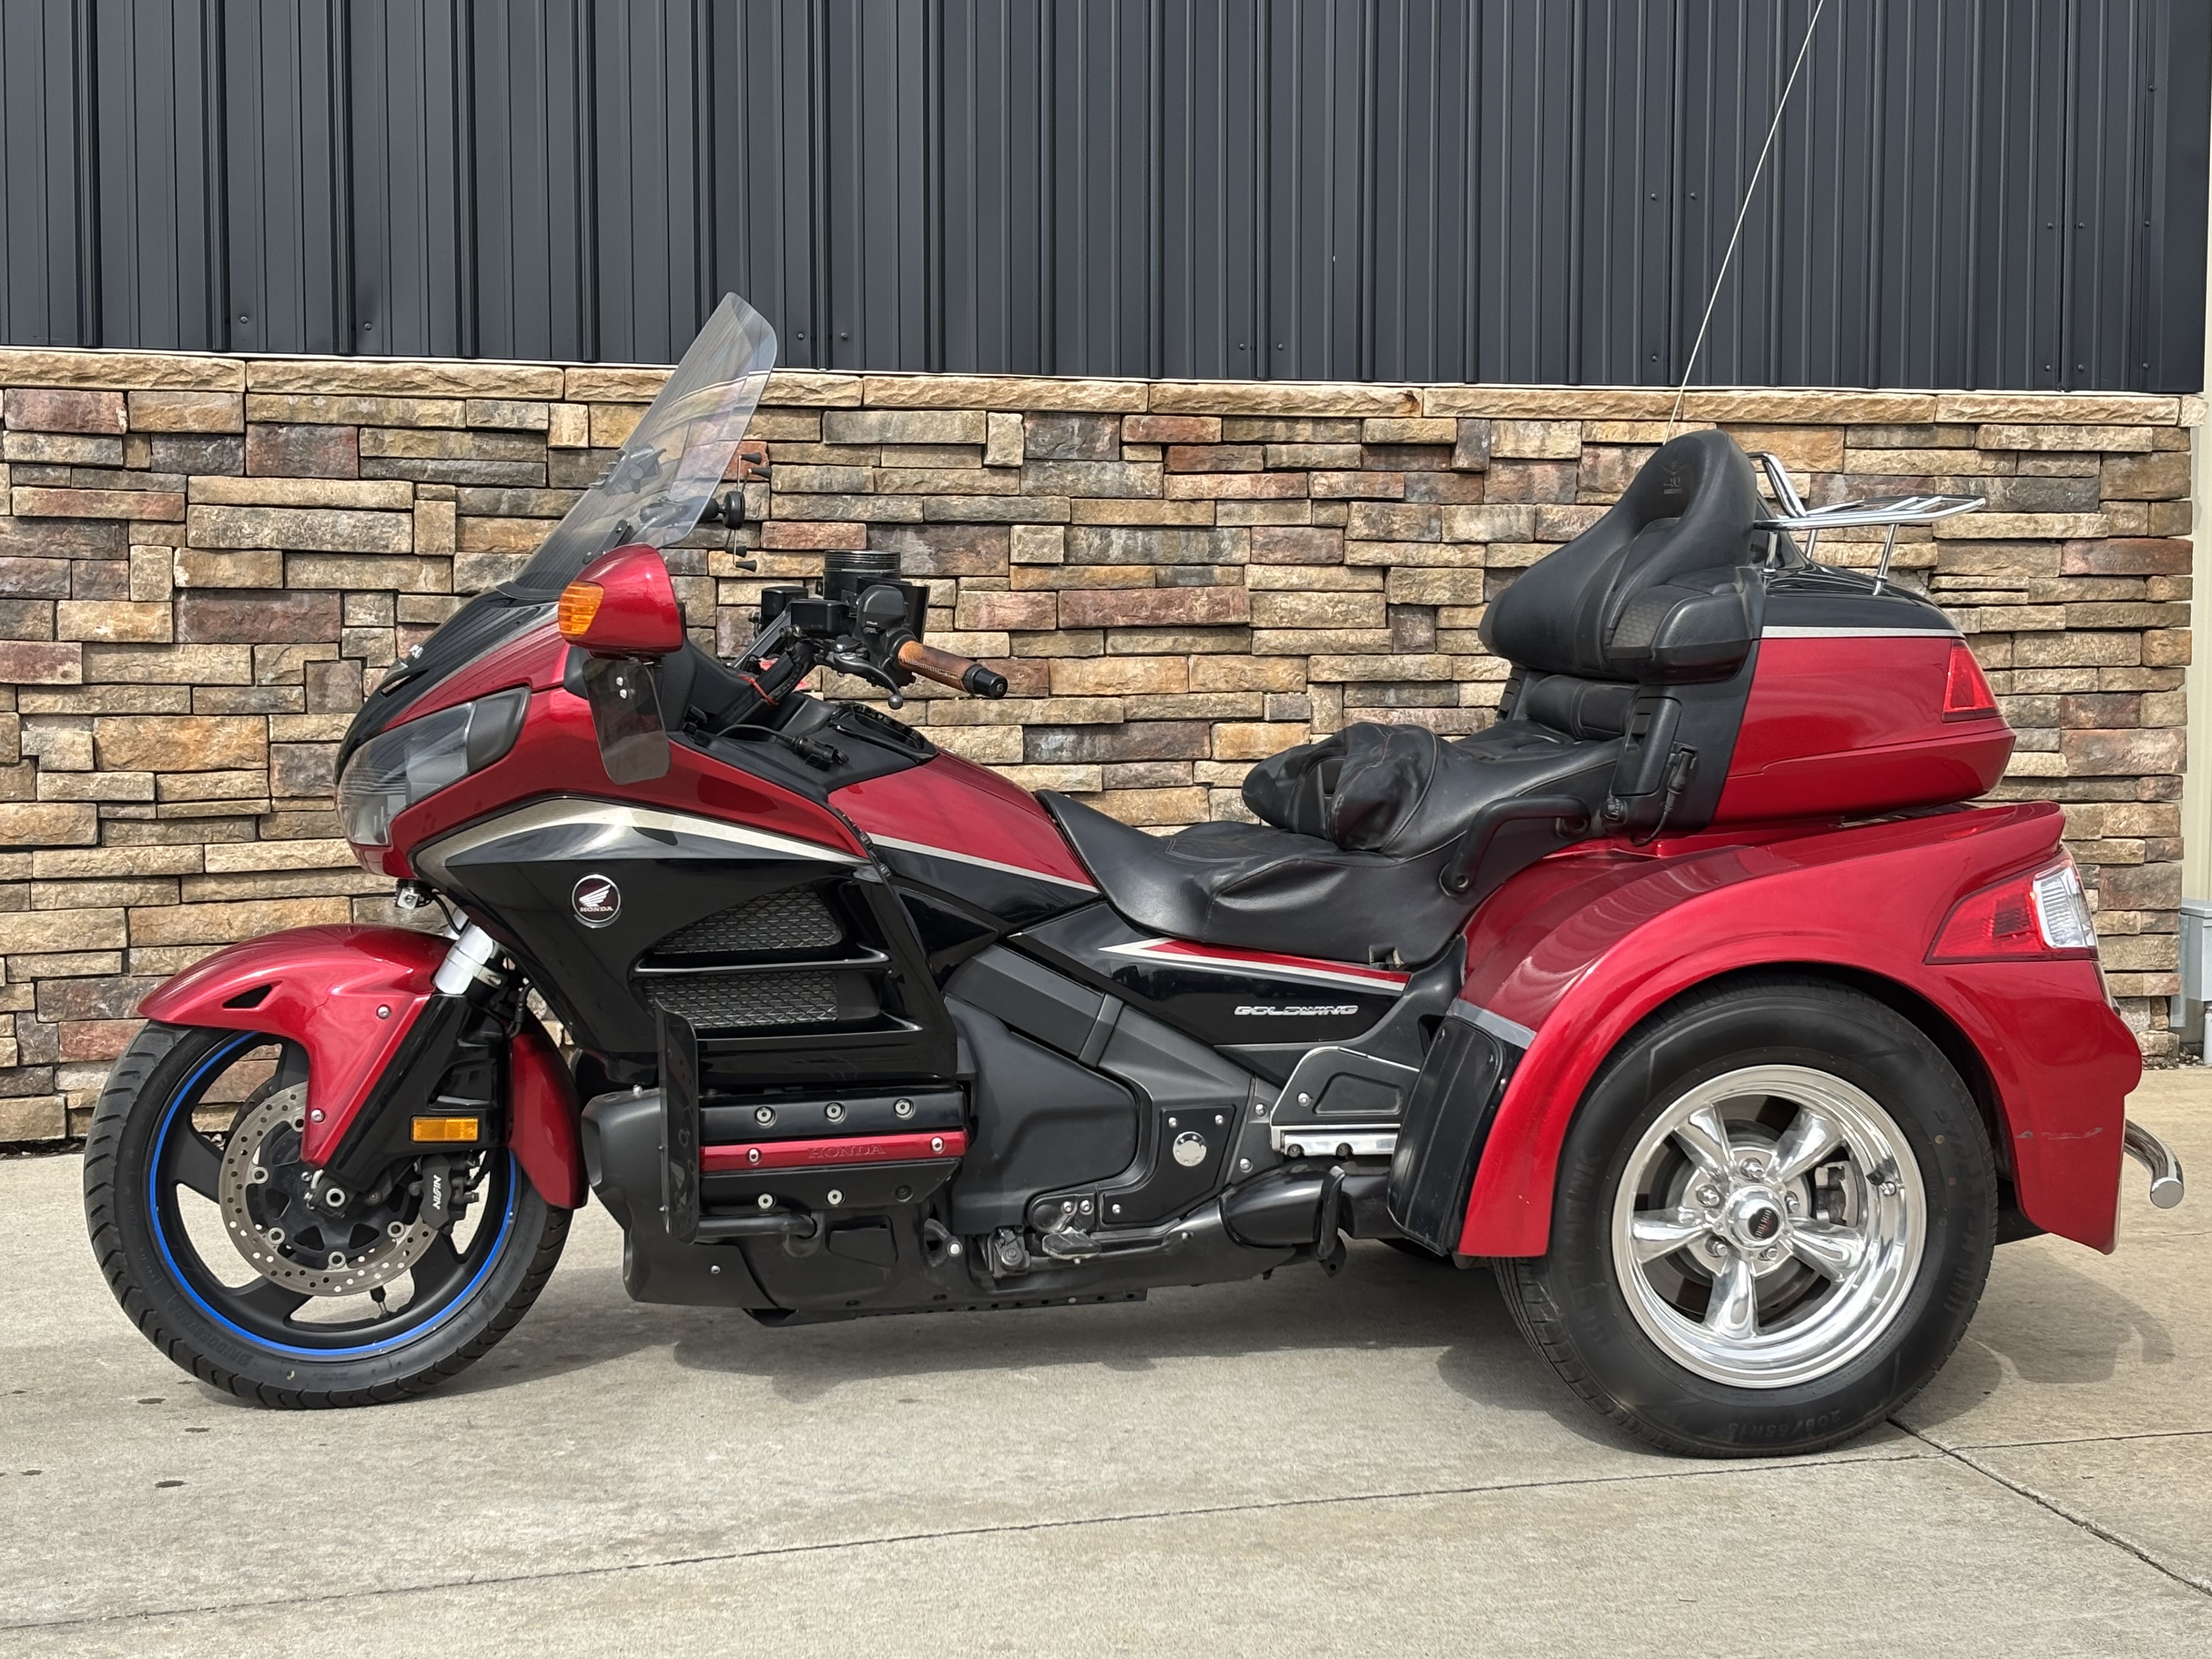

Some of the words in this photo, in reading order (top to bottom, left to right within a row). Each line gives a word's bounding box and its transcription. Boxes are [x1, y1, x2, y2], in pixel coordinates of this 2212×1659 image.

[1234, 1005, 1358, 1015] GOLDWING
[808, 1144, 885, 1159] HONDA
[433, 1175, 442, 1210] NISSIN
[167, 1302, 253, 1368] BRIDGESTONE
